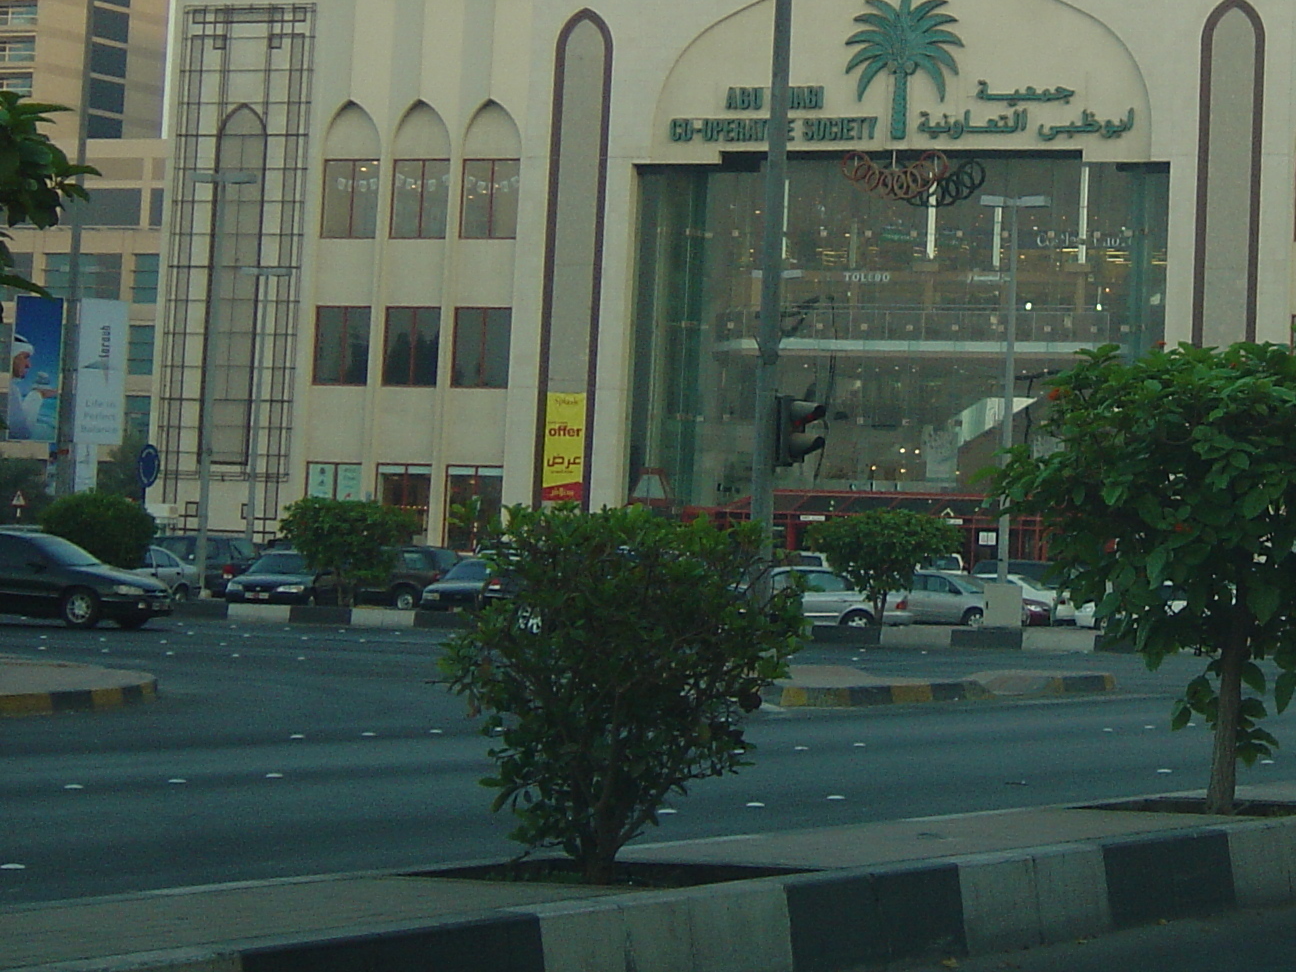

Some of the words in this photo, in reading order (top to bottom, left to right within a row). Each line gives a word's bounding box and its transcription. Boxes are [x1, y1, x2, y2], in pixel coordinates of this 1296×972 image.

[725, 86, 764, 110] ABU
[975, 79, 1075, 108] جمعية
[670, 118, 795, 142] CO-OPERATE
[802, 115, 879, 141] SOCIETY
[916, 107, 1029, 139] التعاونية
[85, 399, 103, 408] Life
[548, 425, 582, 437] offer
[547, 453, 581, 469] عرض
